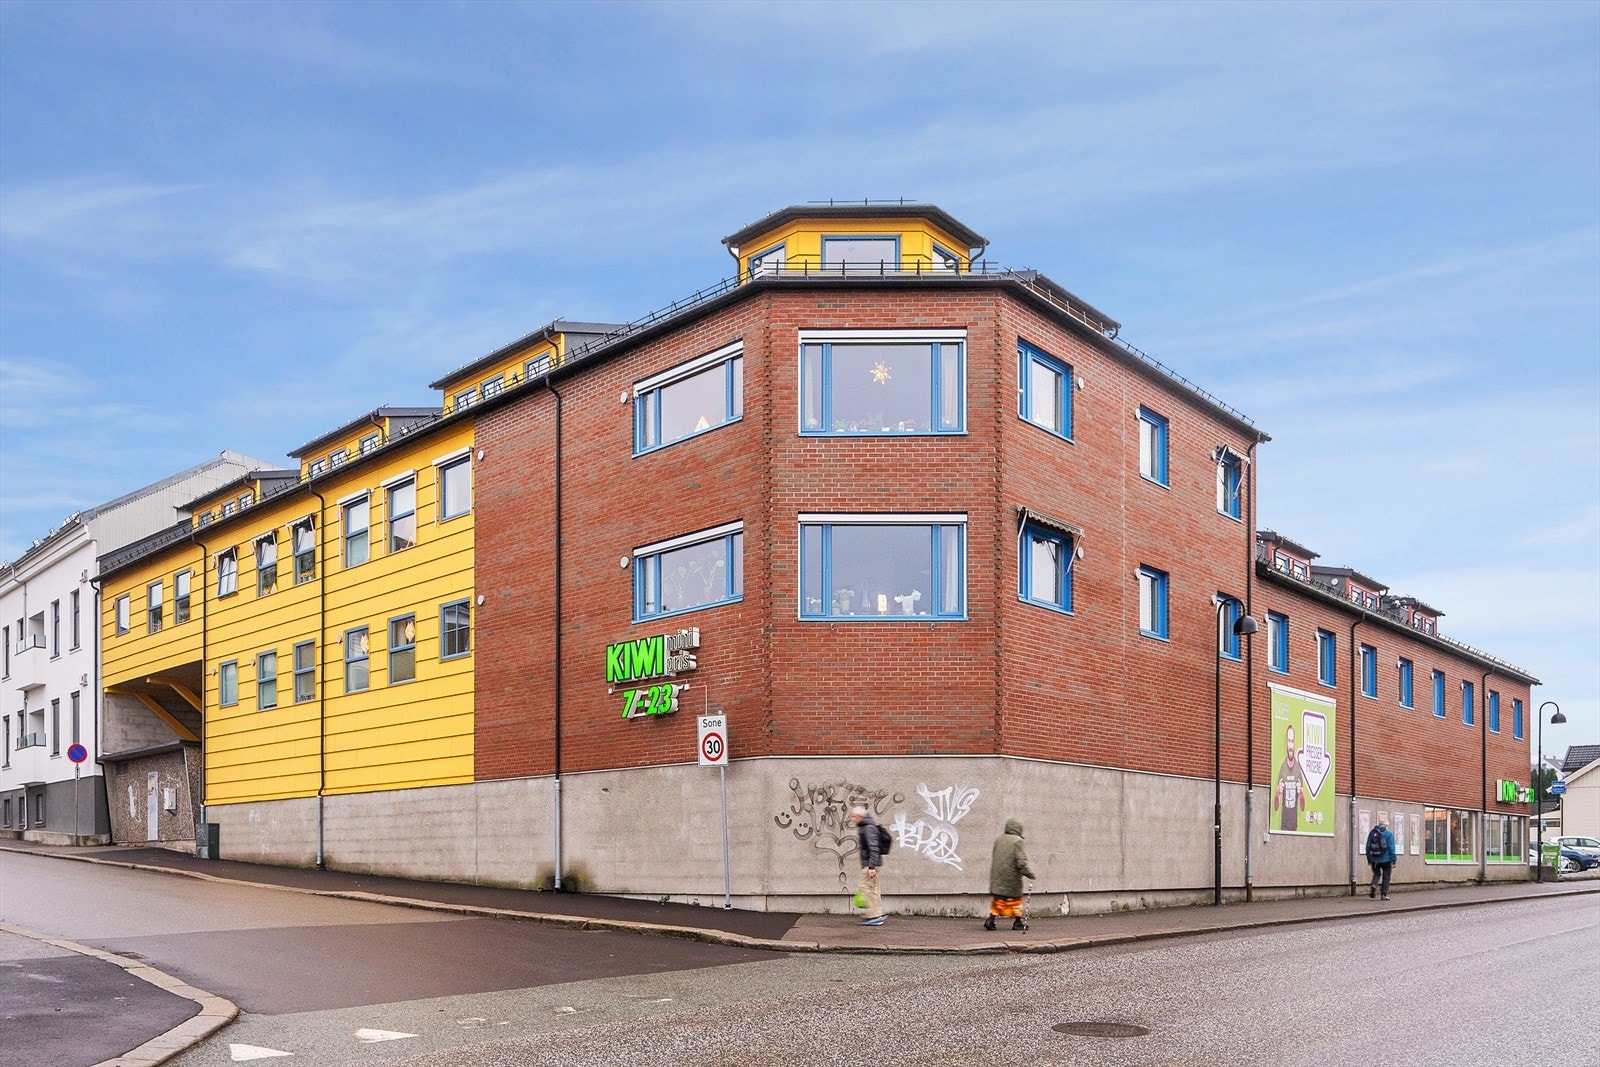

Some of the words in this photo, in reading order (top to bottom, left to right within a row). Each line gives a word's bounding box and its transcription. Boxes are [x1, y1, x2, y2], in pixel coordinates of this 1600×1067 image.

[606, 634, 665, 683] KIWI
[666, 650, 690, 676] pris
[621, 683, 674, 719] 7-23
[702, 718, 722, 728] Sone
[706, 739, 721, 755] 30
